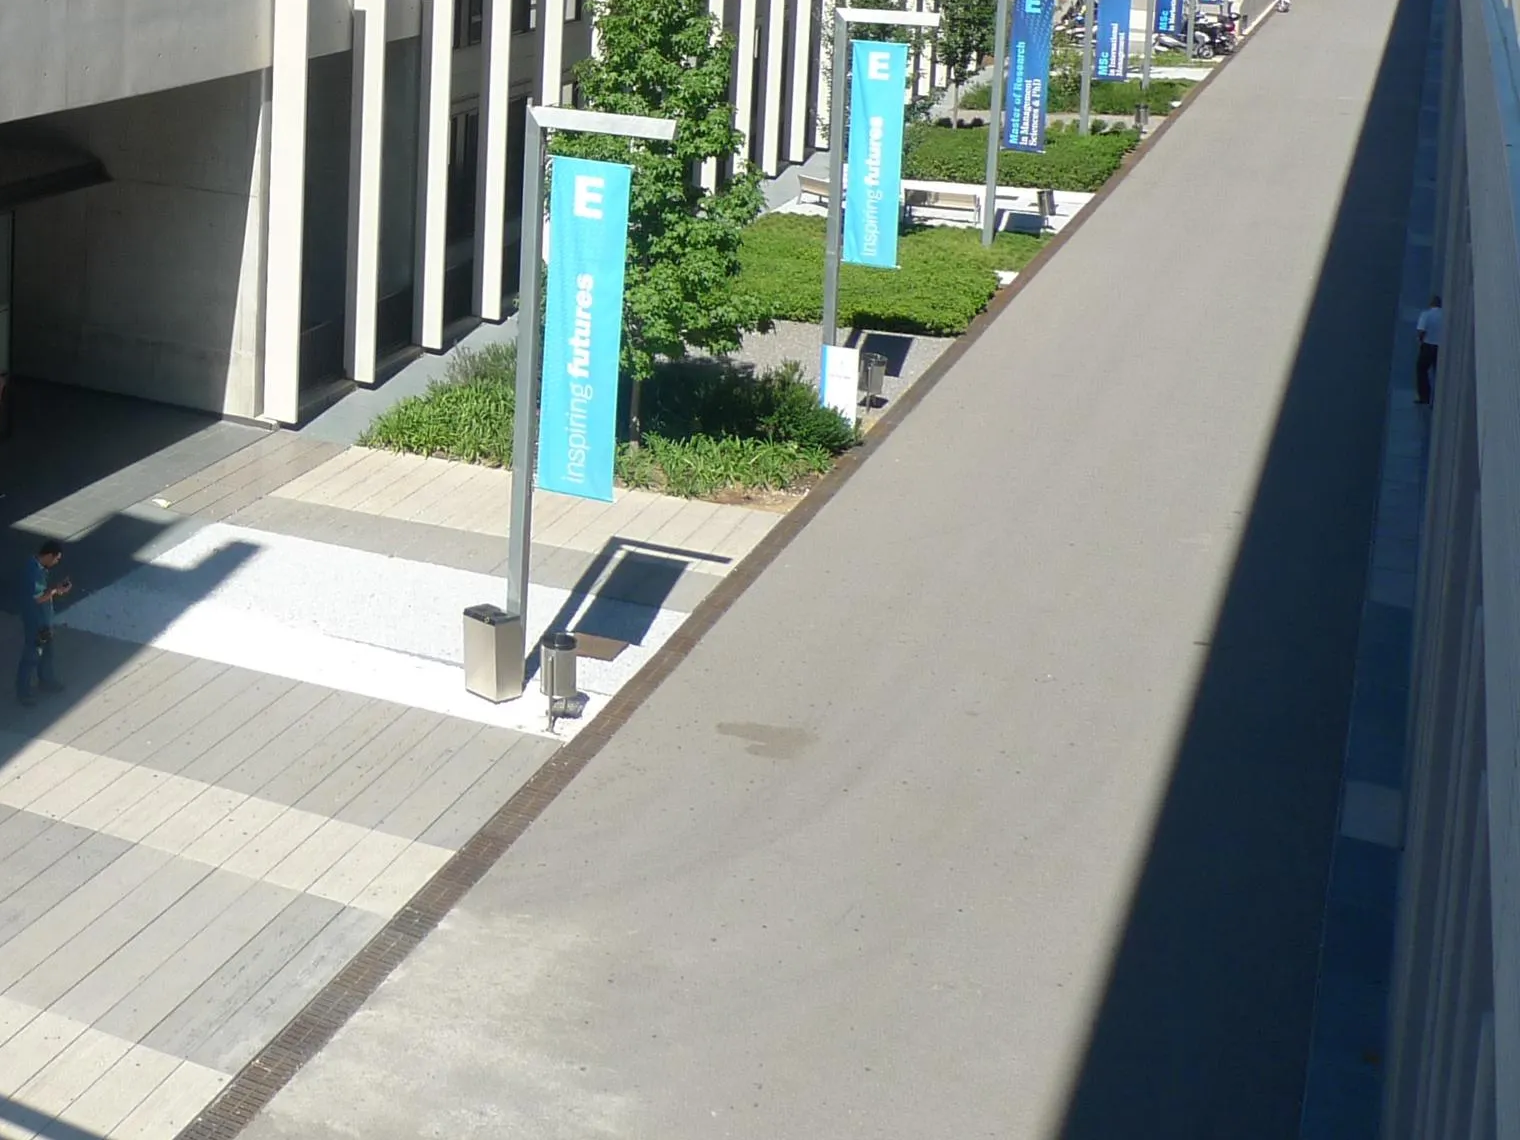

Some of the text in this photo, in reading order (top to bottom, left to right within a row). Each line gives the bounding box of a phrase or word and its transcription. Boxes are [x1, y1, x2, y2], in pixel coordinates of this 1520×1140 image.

[1159, 10, 1169, 31] MSc
[867, 51, 890, 81] E
[1098, 51, 1109, 76] MSc
[1009, 41, 1025, 144] Master of Research
[1032, 78, 1042, 98] PhD
[1020, 79, 1033, 146] in Management
[1029, 109, 1040, 147] Sciences
[573, 175, 605, 220] E
[861, 116, 884, 257] inspiring futures
[562, 273, 595, 483] inspiring futures
